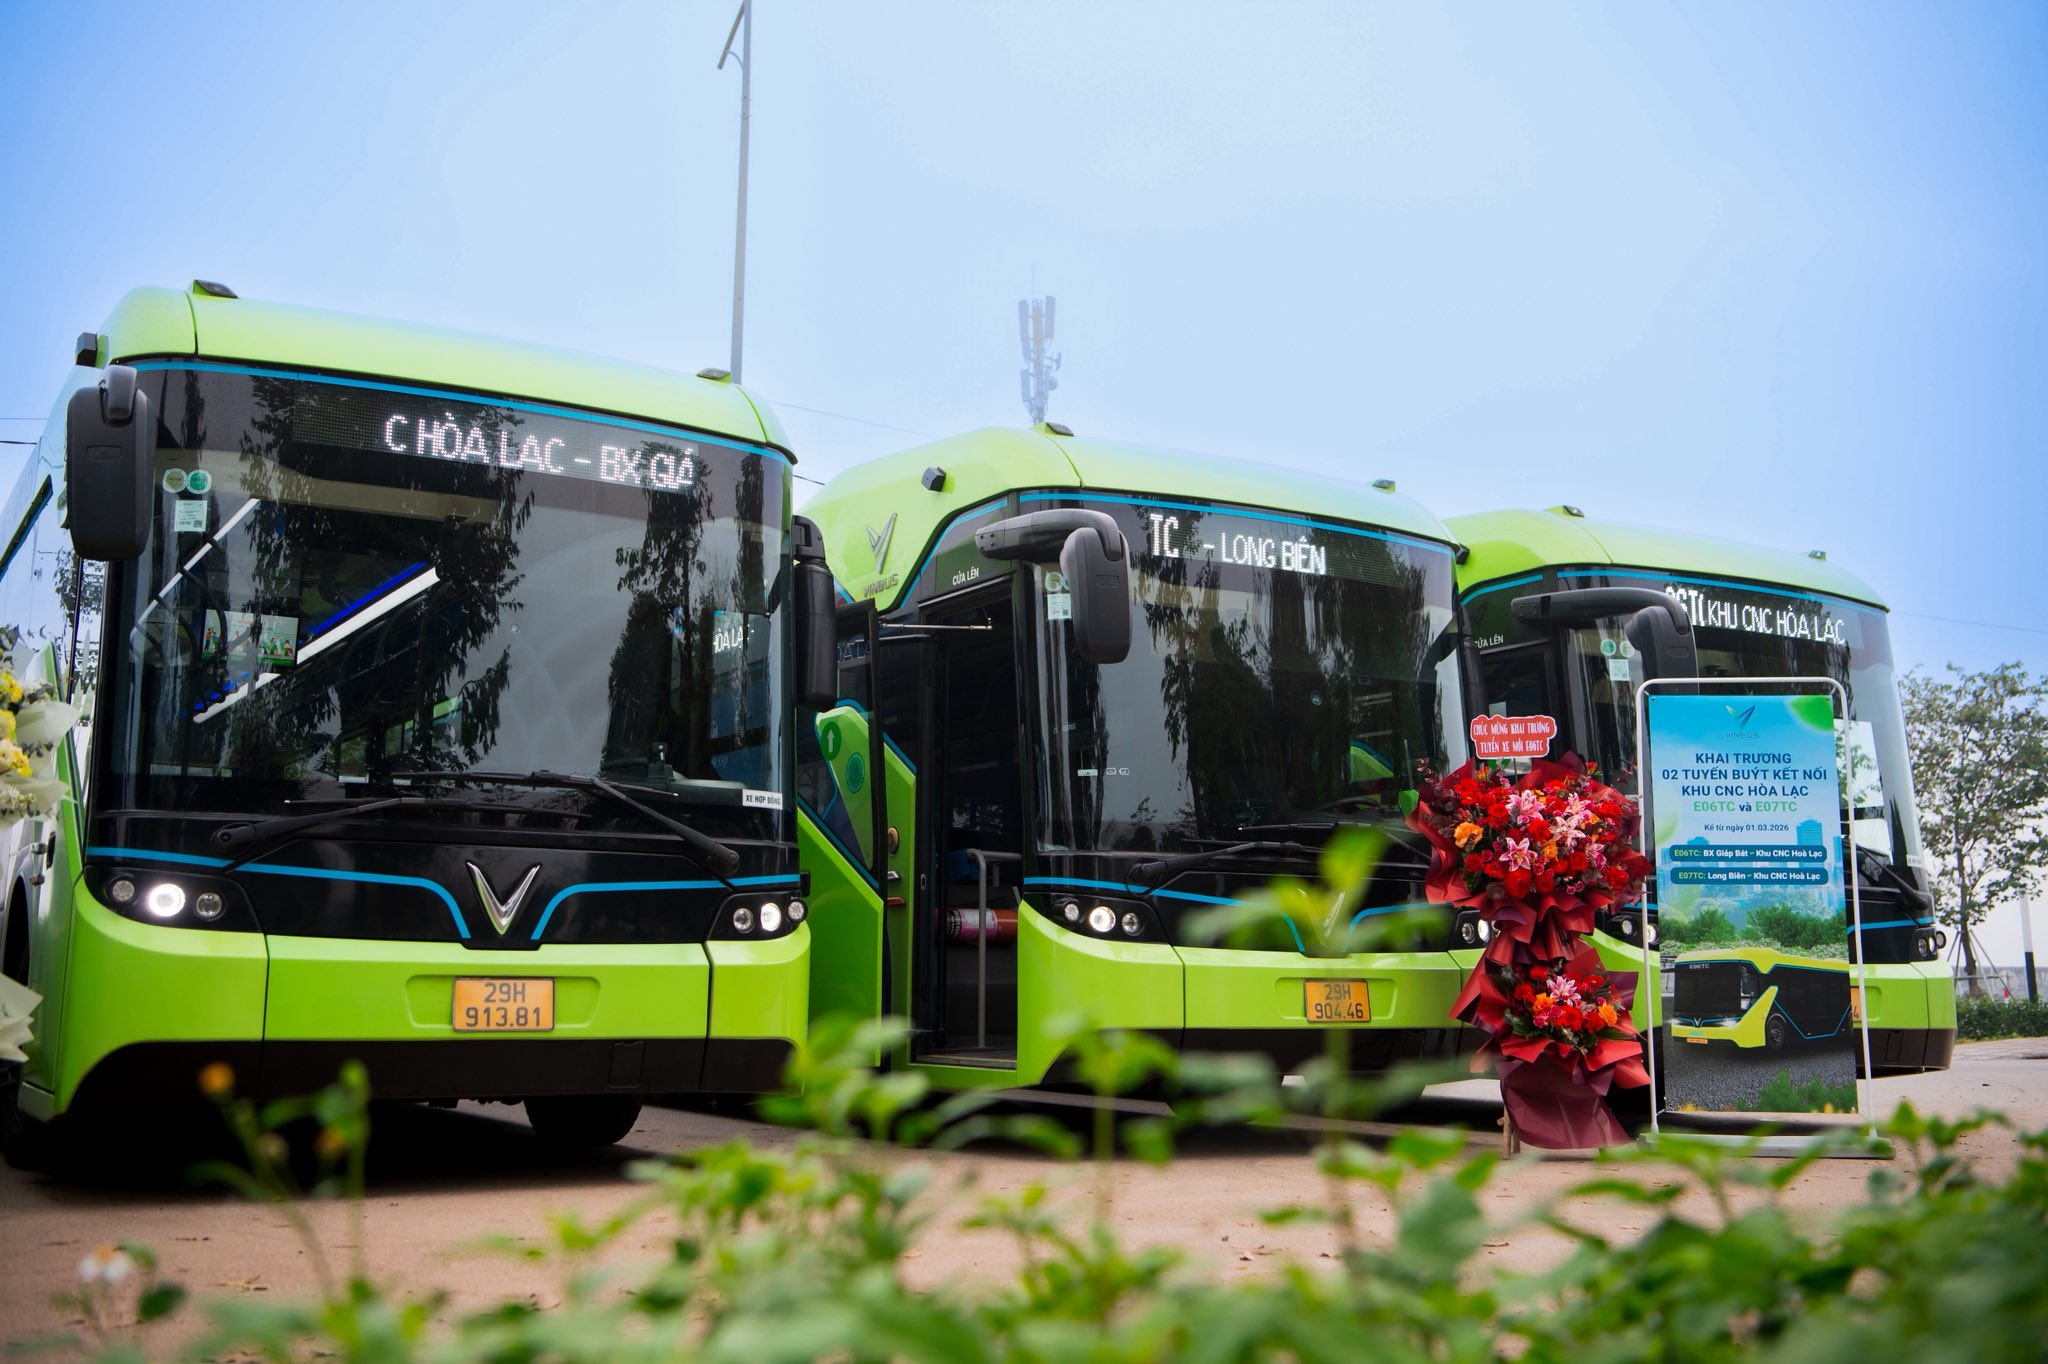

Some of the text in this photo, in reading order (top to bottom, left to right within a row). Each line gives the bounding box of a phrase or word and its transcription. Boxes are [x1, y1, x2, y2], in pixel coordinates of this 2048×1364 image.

[417, 412, 490, 464] HÒA
[599, 445, 642, 485] BX
[1221, 532, 1276, 569] LONG
[1281, 536, 1327, 576] BIÊN
[967, 566, 980, 581] LÊN
[1707, 599, 1739, 629] KHU
[1741, 604, 1774, 635] CNC
[1775, 604, 1812, 640] HÒA
[1490, 633, 1504, 647] LÊN
[1510, 722, 1525, 735] KHAI
[1502, 741, 1511, 753] XE
[1695, 752, 1792, 764] KHAI TRƯƠNG
[1662, 766, 1827, 780] 02 TUYẾN BUÝT KẾT NỐI
[1682, 783, 1809, 799] KHU CNC HÒA LẠC
[745, 794, 753, 803] XE
[1693, 801, 1799, 813] E06TC và E07TC
[1725, 824, 1745, 833] ngày
[1745, 824, 1790, 832] 01.03.2026
[1674, 849, 1702, 857] E06TC:
[1703, 849, 1715, 857] BX
[1716, 849, 1734, 858] Giáp
[1735, 849, 1748, 857] Bát
[1755, 849, 1771, 857] Khu
[1772, 849, 1790, 857] CNC
[1791, 849, 1808, 857] Hoà
[1808, 849, 1823, 859] Lạc
[1707, 872, 1727, 881] Long
[1728, 871, 1746, 879] Biên
[1753, 871, 1769, 880] Khu
[1770, 872, 1788, 880] CNC
[1789, 871, 1805, 880] Hoà
[1806, 872, 1821, 881] Lạc
[483, 982, 526, 1003] 29H
[1324, 983, 1352, 1001] 29H
[465, 1006, 541, 1028] 913.81
[1314, 1002, 1364, 1020] 904.46
